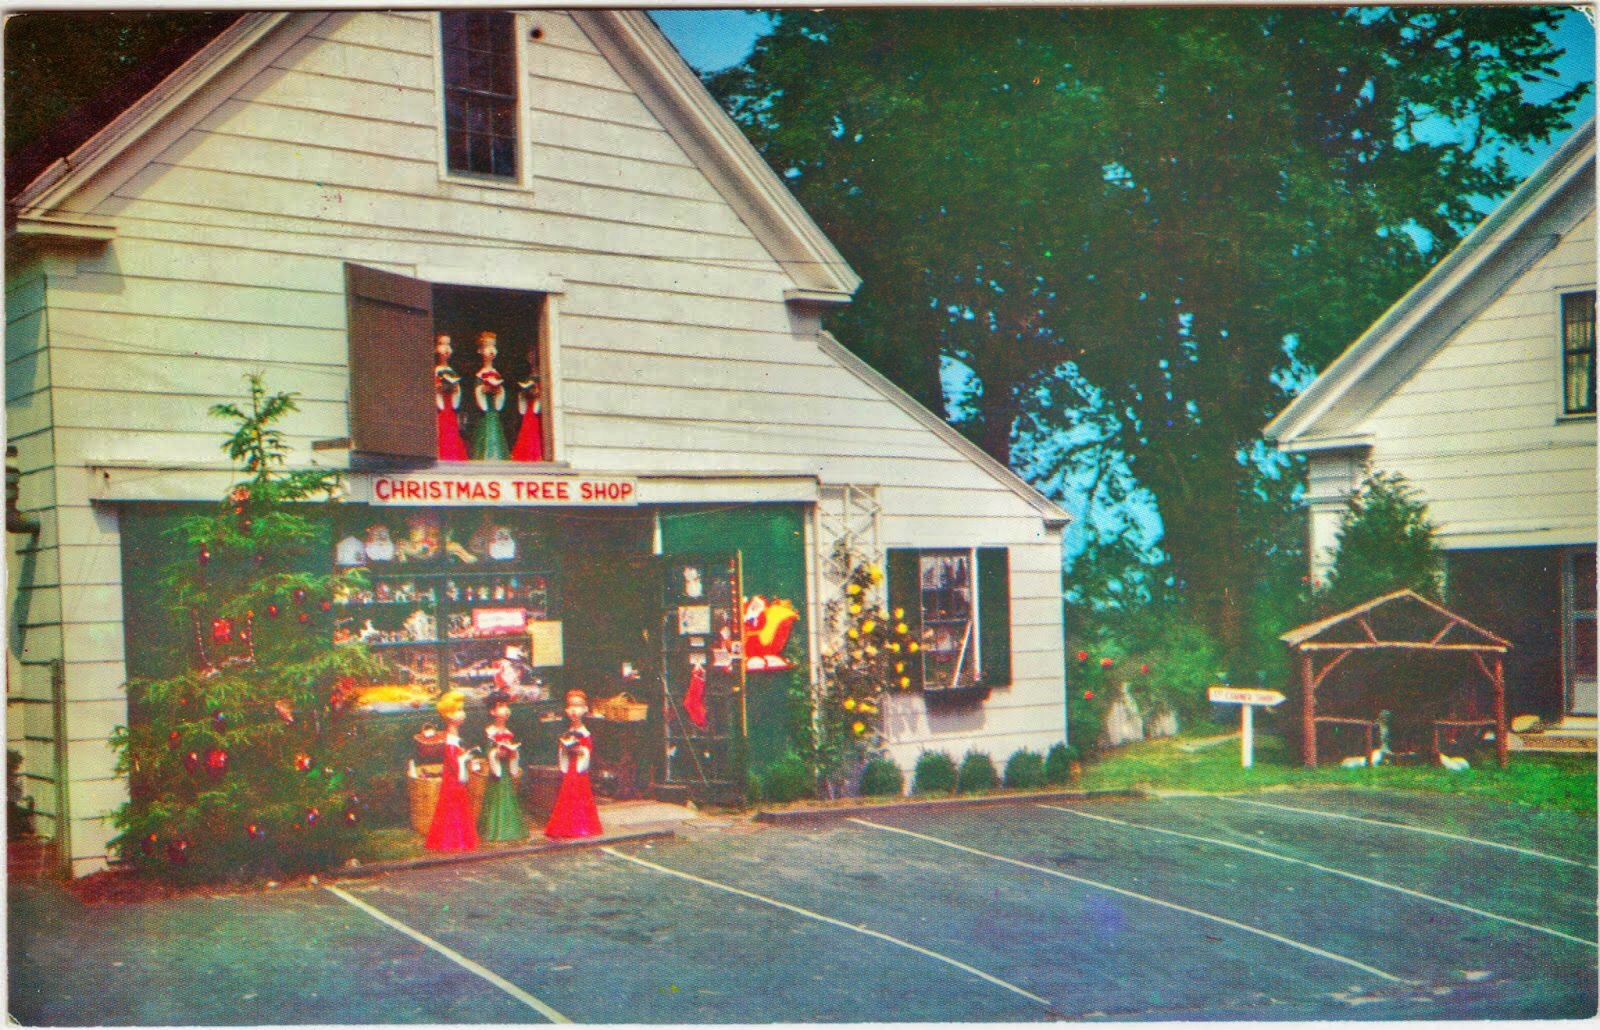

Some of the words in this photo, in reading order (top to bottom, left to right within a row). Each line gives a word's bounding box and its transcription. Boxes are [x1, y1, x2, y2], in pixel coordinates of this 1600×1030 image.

[375, 479, 501, 500] CHRISTMAS
[511, 481, 569, 499] TREE
[580, 482, 633, 500] SHOP
